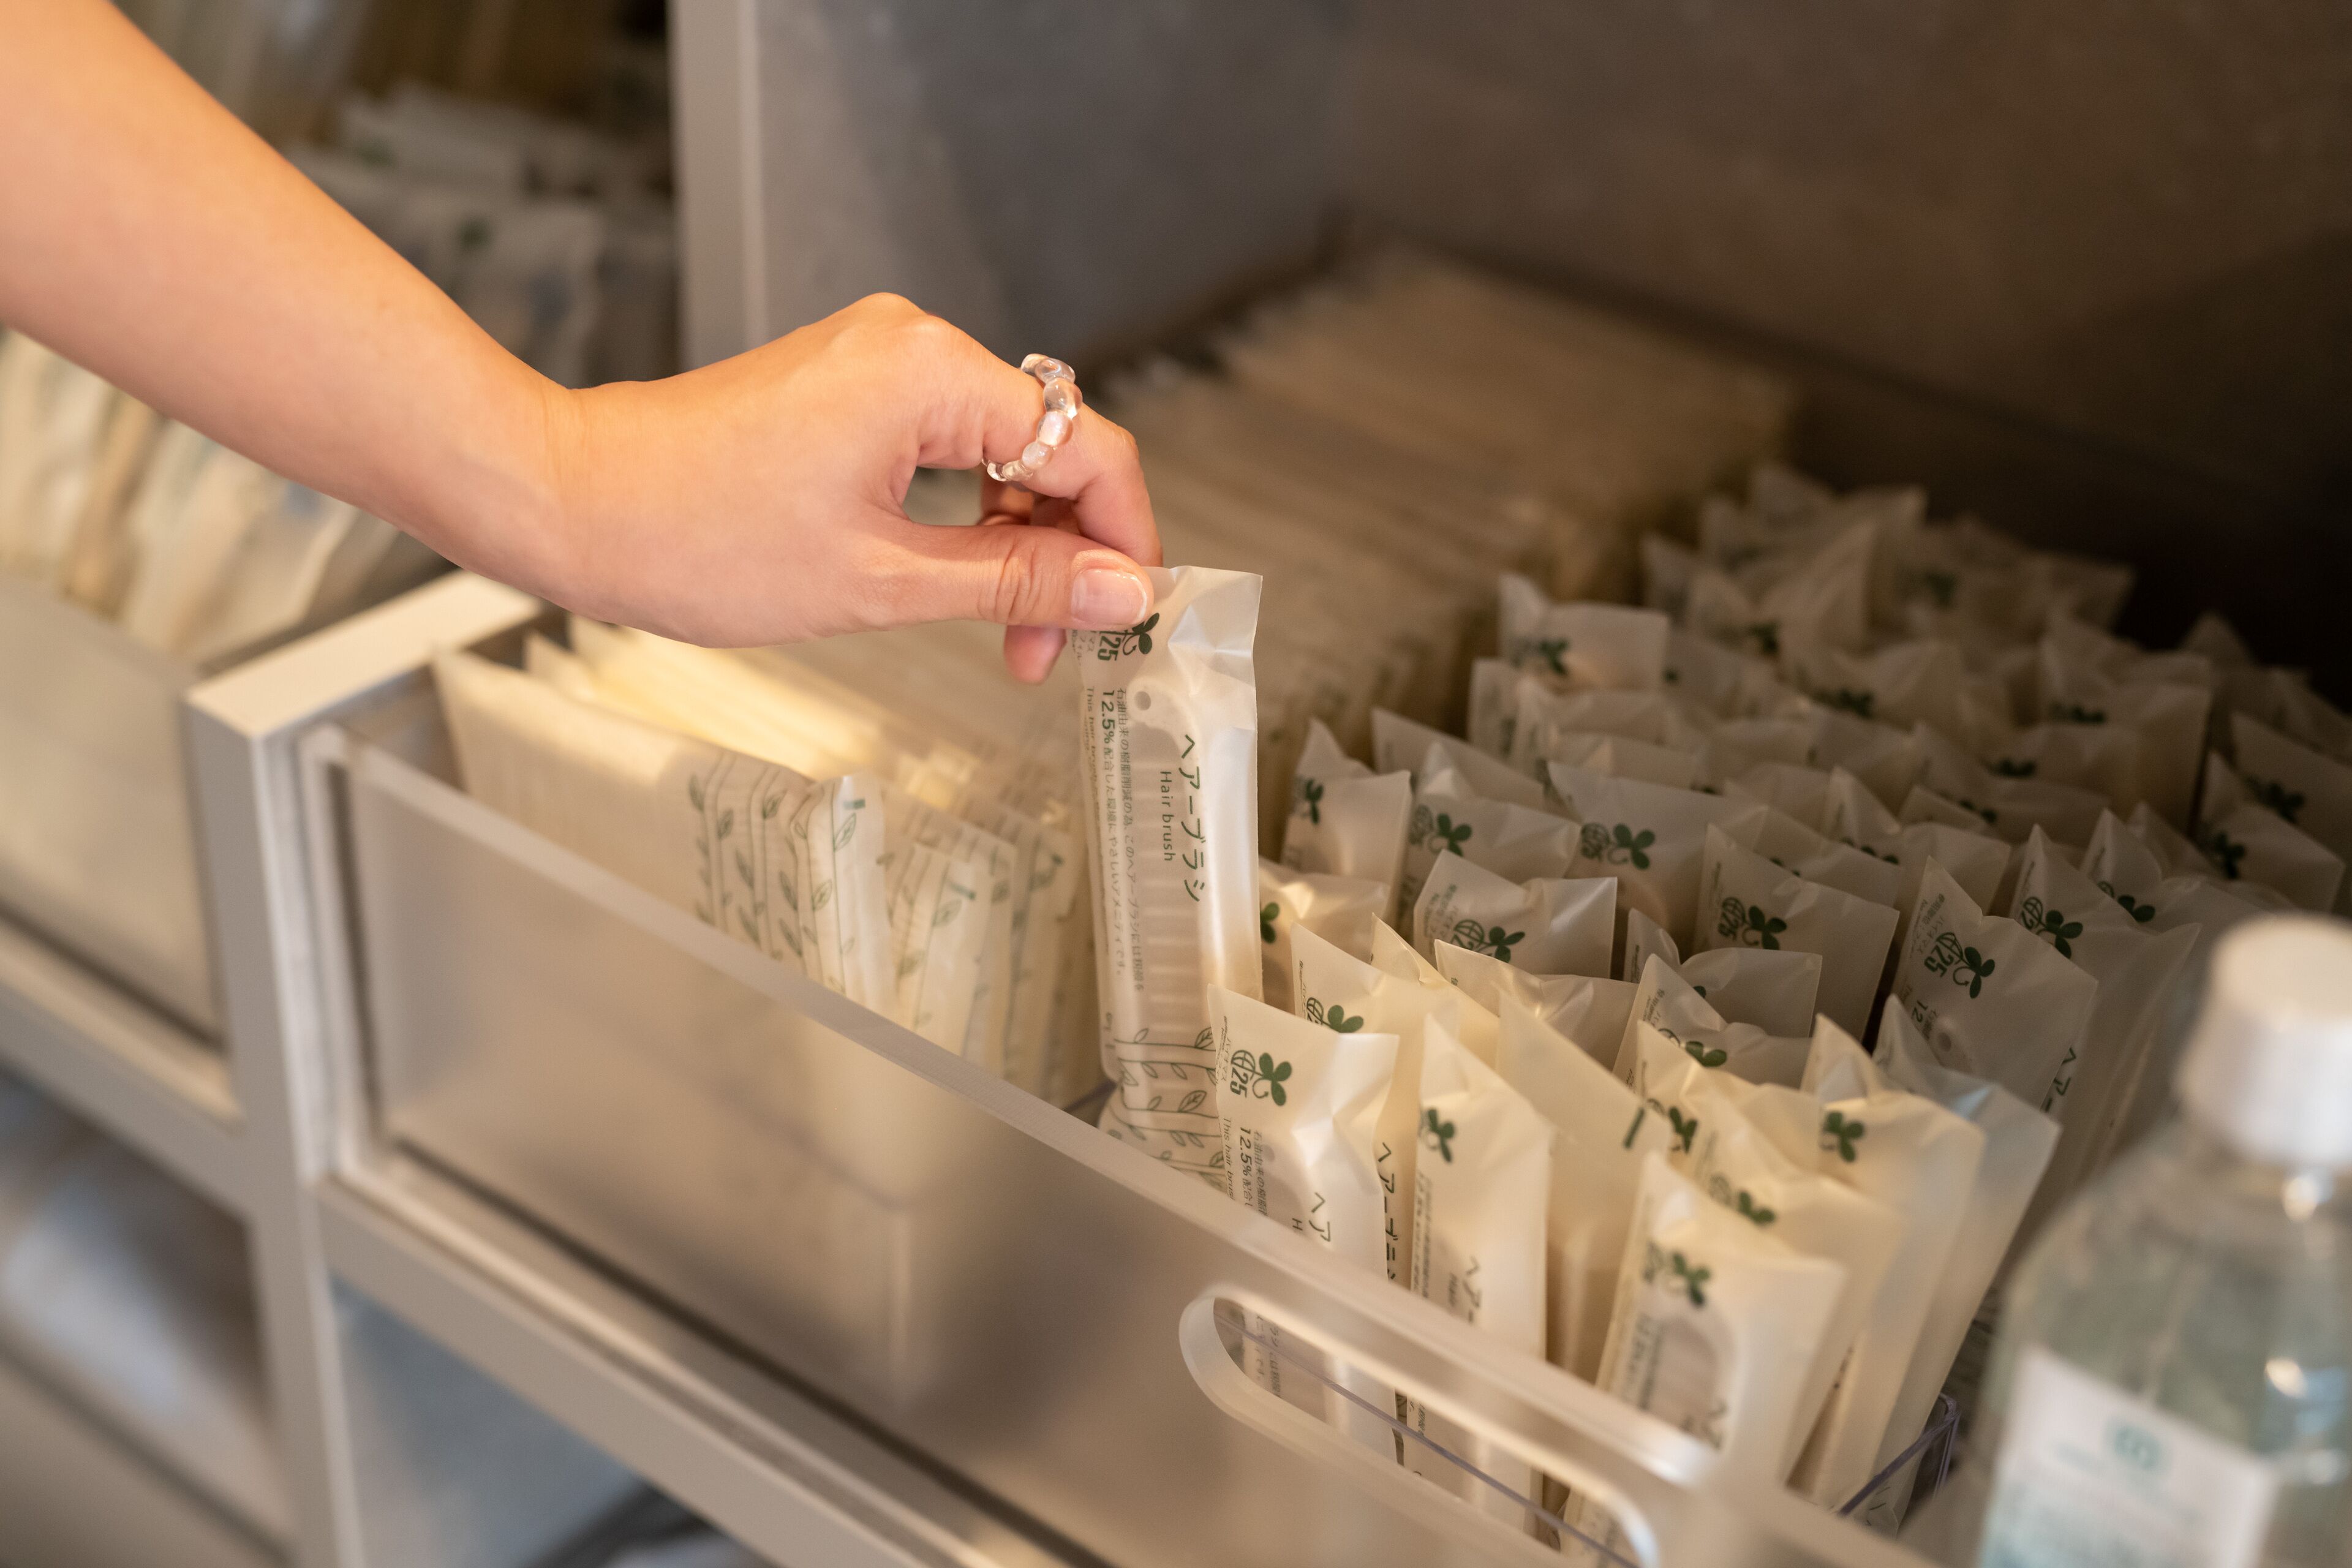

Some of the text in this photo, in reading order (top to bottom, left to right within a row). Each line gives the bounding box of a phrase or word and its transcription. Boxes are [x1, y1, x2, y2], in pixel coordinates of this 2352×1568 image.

[1098, 636, 1120, 661] 25
[1147, 734, 1206, 902] ヘアーブラシ
[1160, 771, 1176, 861] Hair brush
[1924, 945, 1954, 978] 25
[1229, 1061, 1248, 1098] 25
